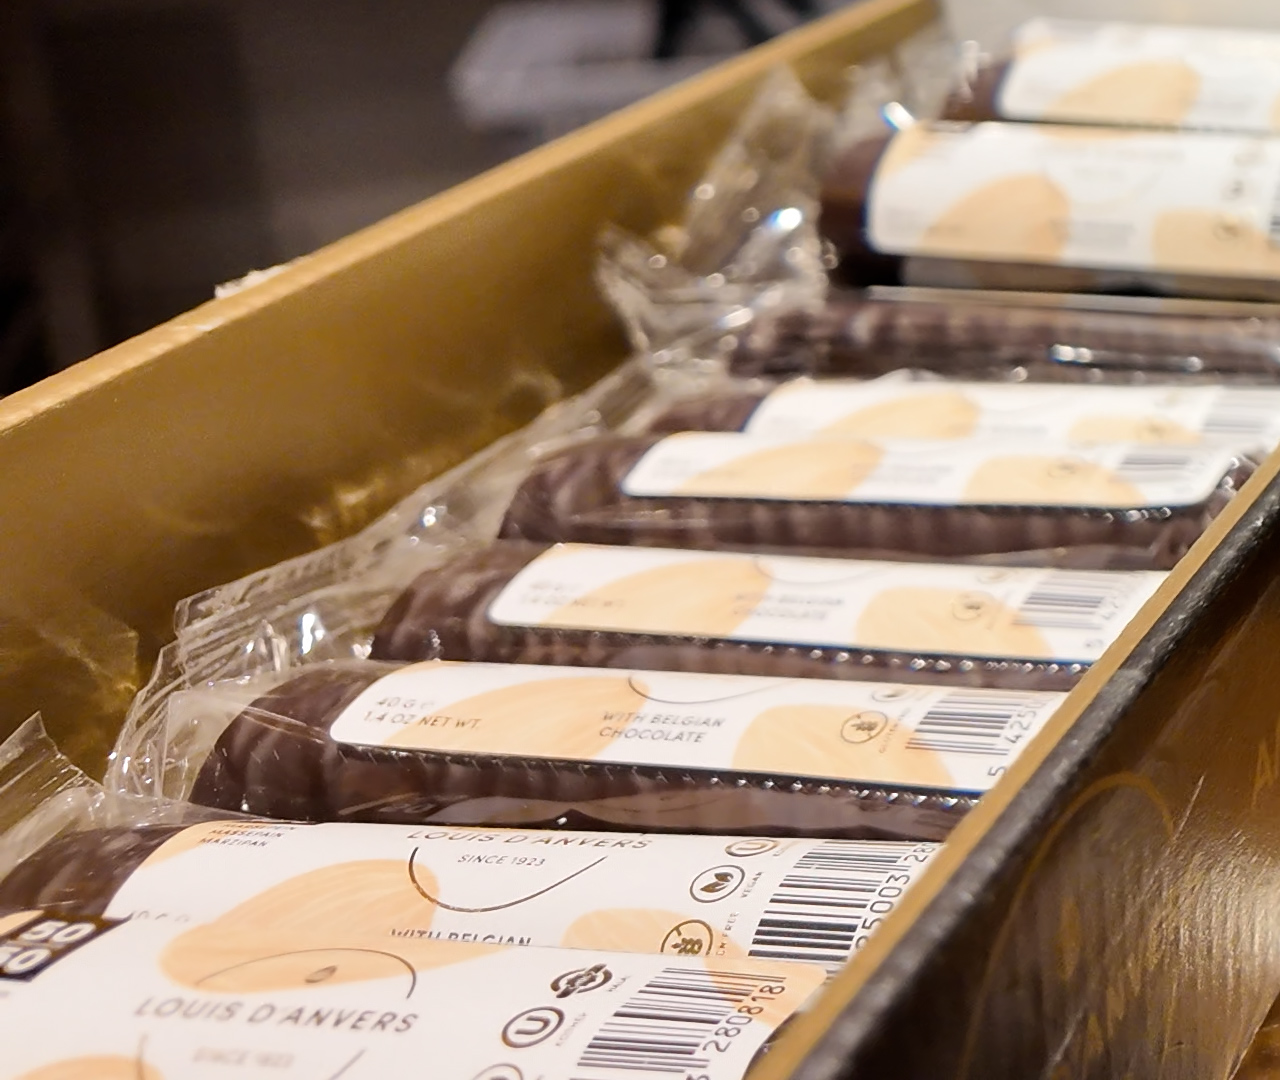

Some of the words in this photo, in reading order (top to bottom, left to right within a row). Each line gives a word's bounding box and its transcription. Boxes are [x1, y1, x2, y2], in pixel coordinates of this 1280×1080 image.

[391, 713, 418, 725] OZ
[420, 715, 455, 728] NET
[602, 710, 646, 723] WITH
[649, 713, 726, 728] BELGIAN
[599, 726, 706, 743] CHOCOLATE
[406, 830, 500, 843] LOUIS
[457, 854, 506, 866] SINCE
[511, 856, 547, 867] 1923
[134, 997, 243, 1020] LOUIS
[702, 983, 786, 1053] 280818
